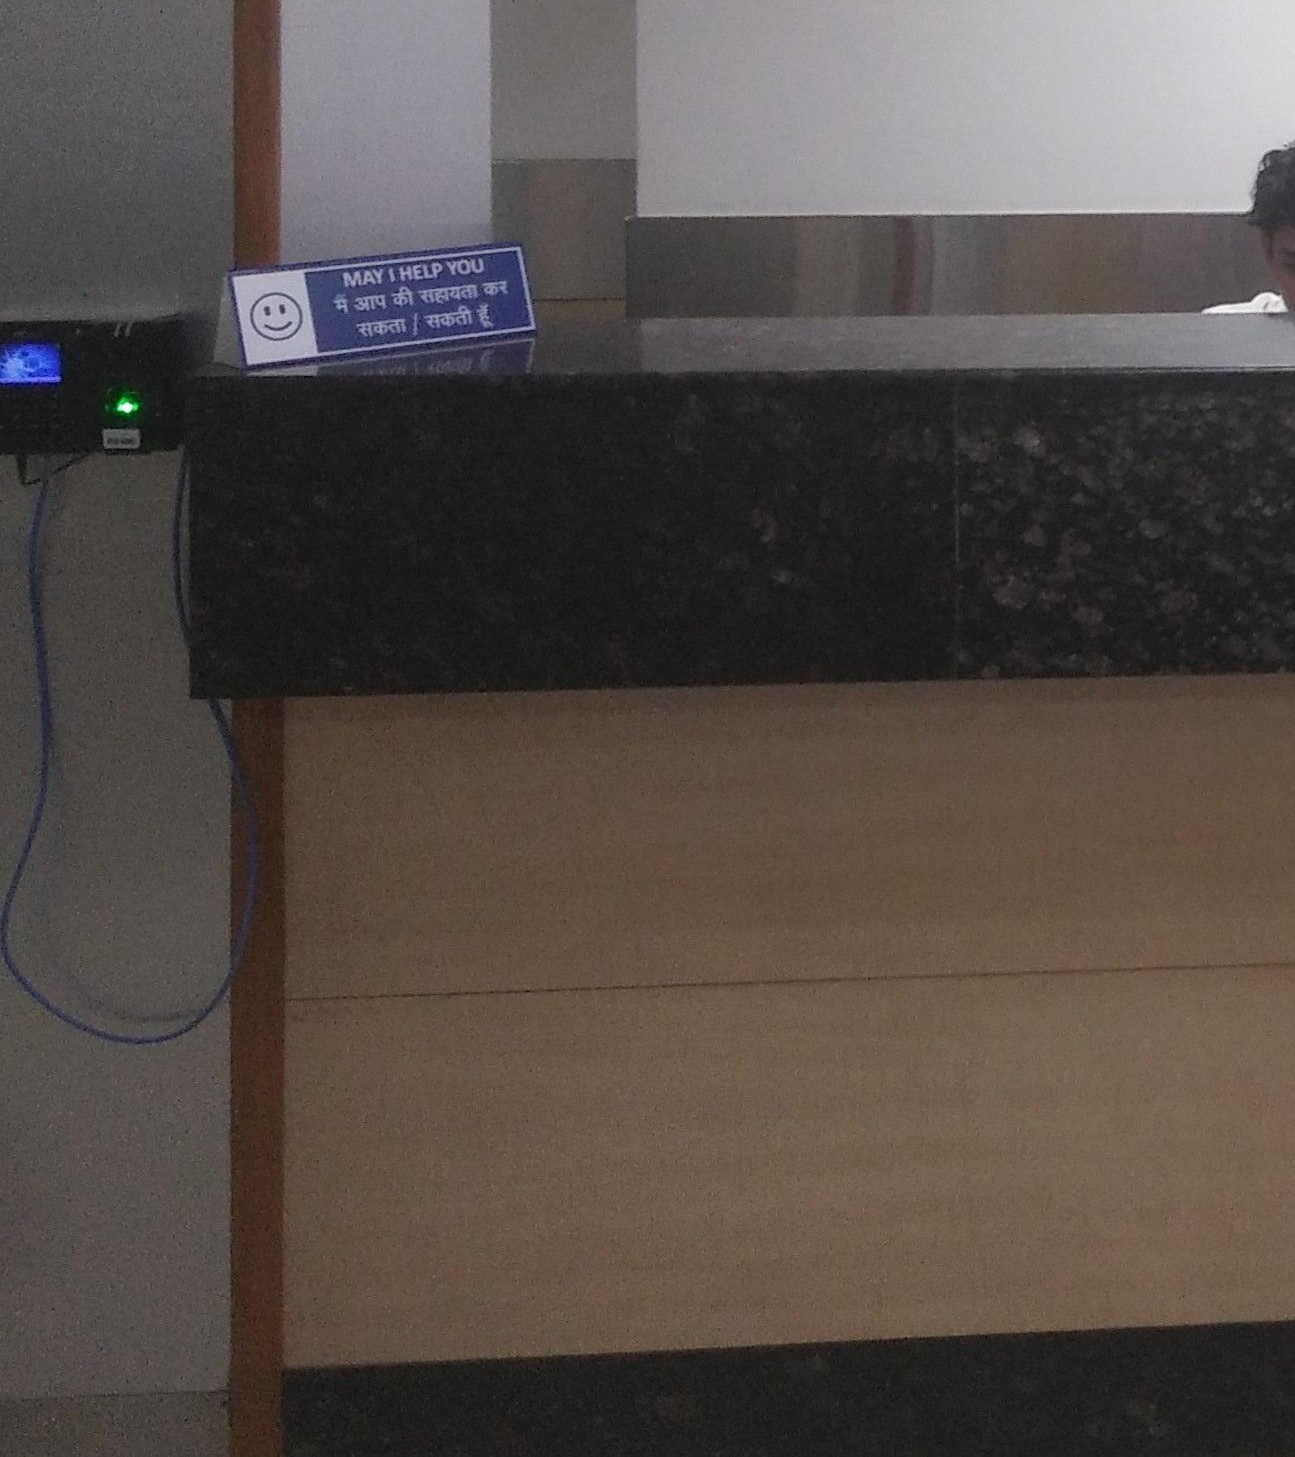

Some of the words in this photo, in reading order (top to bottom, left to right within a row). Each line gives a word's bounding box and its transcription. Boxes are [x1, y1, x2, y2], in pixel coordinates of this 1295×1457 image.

[342, 269, 387, 287] MAY
[389, 268, 396, 282] I
[400, 262, 443, 281] HELP
[447, 258, 484, 275] YOU
[354, 294, 387, 311] आप
[391, 286, 414, 306] की
[419, 284, 478, 304] सहायता
[482, 280, 508, 295] कर
[356, 318, 407, 337] सकता
[424, 305, 473, 329] सकती
